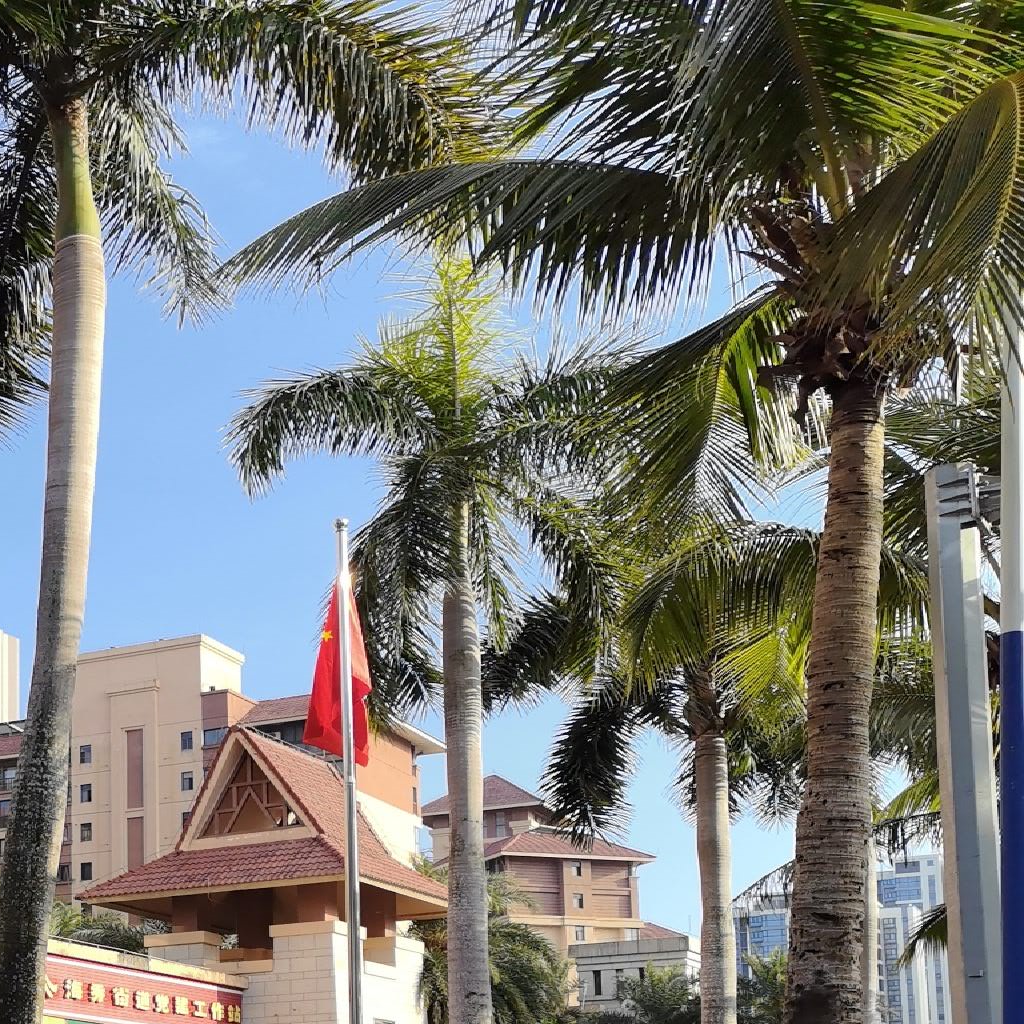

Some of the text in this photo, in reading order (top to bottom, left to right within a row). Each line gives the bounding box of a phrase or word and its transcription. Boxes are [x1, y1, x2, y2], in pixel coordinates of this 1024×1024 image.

[63, 978, 242, 1024] 海秀街道党建工作站
